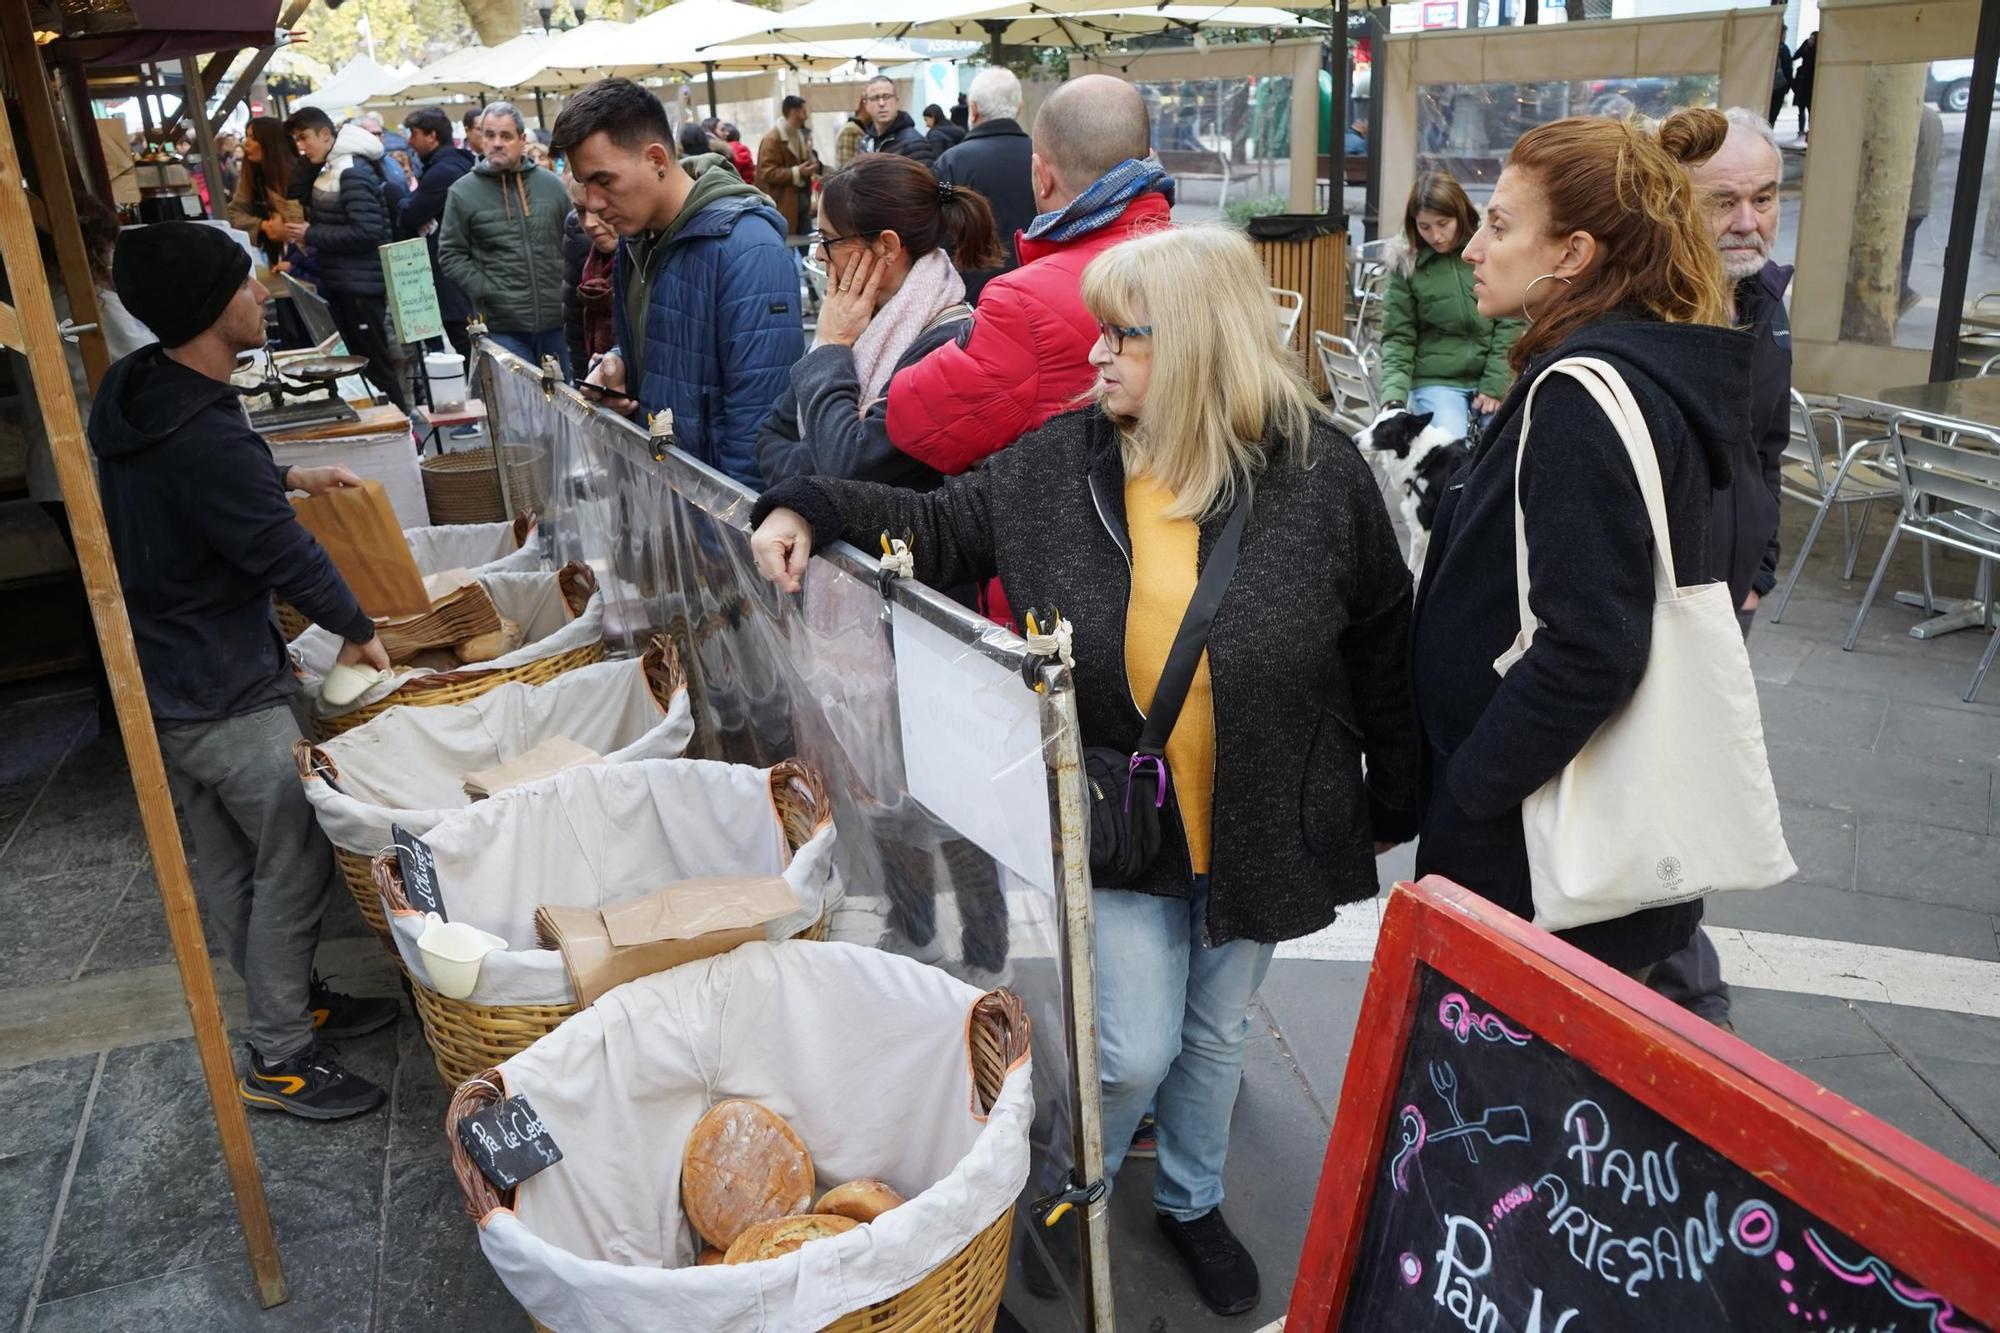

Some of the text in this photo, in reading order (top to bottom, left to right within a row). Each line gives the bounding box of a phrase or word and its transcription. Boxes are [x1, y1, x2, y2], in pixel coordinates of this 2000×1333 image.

[472, 1121, 502, 1156] Pa
[495, 1119, 521, 1149] de
[1564, 1099, 1680, 1207] PAN
[1533, 1173, 1780, 1297] ARTESANO
